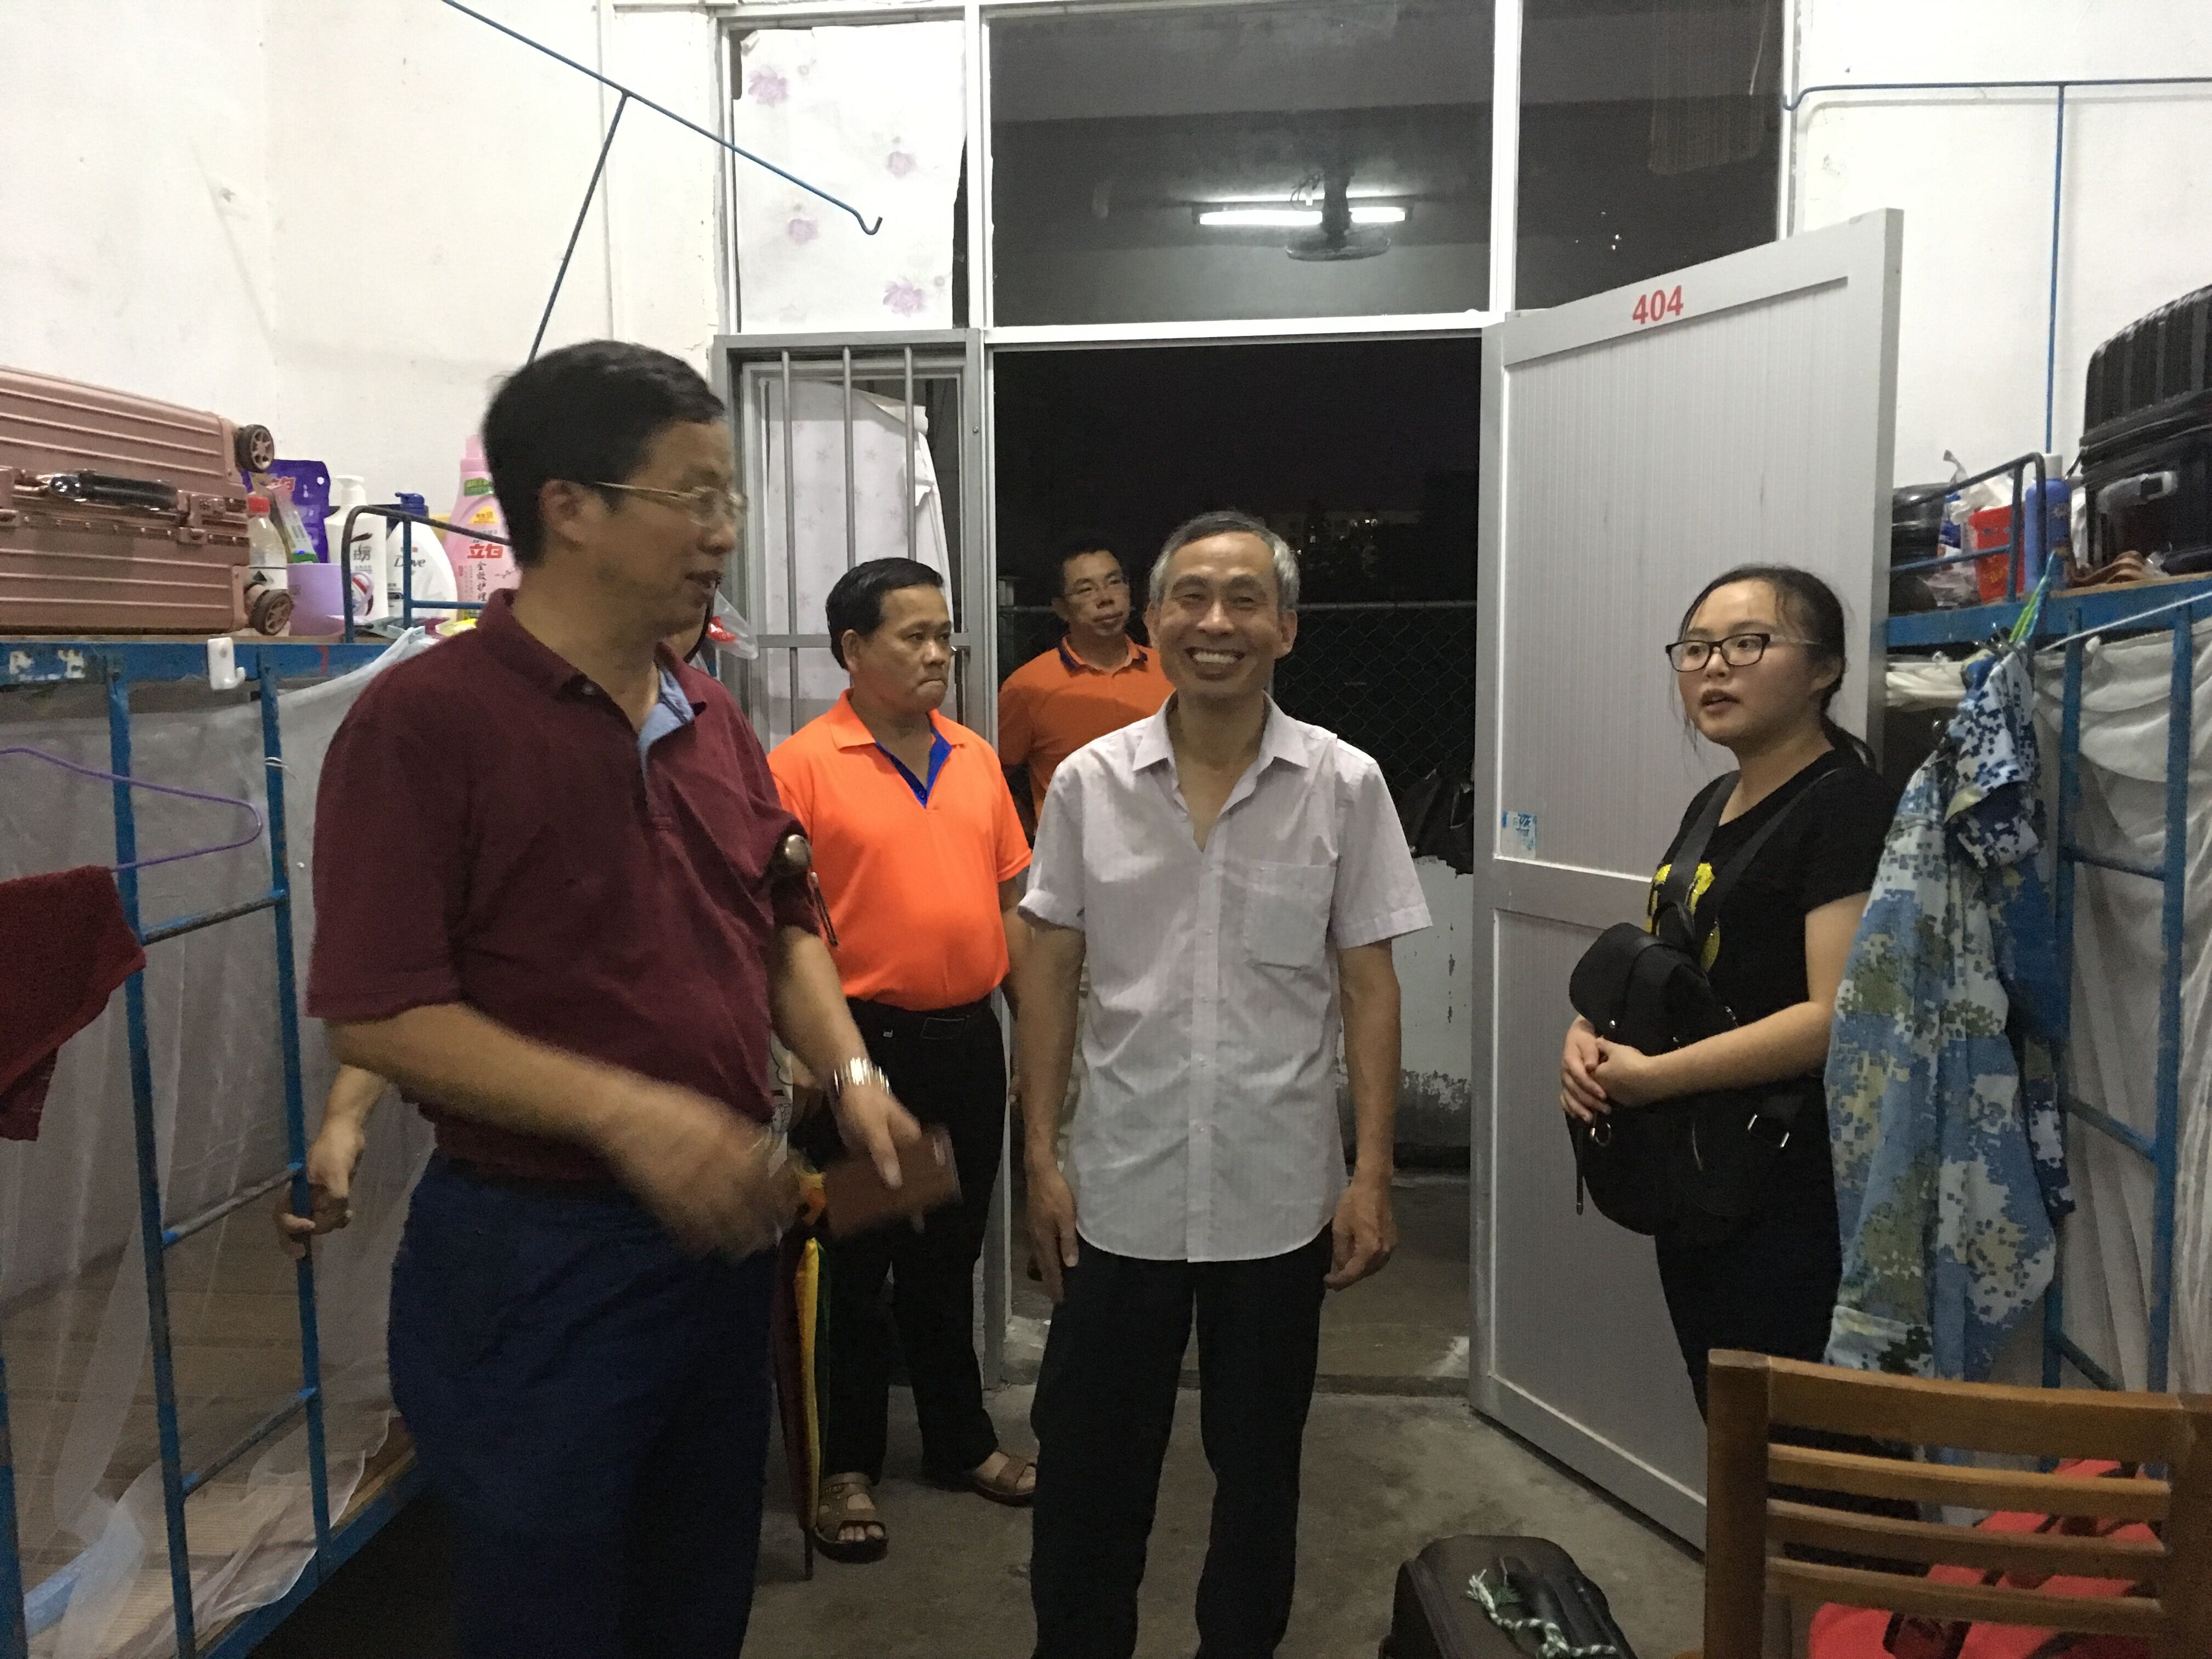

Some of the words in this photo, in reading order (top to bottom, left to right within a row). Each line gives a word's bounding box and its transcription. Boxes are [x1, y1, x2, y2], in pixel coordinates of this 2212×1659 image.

[1632, 285, 1684, 325] 404
[394, 555, 426, 568] Dve
[466, 543, 504, 559] 立白
[476, 561, 487, 601] 全效护理
